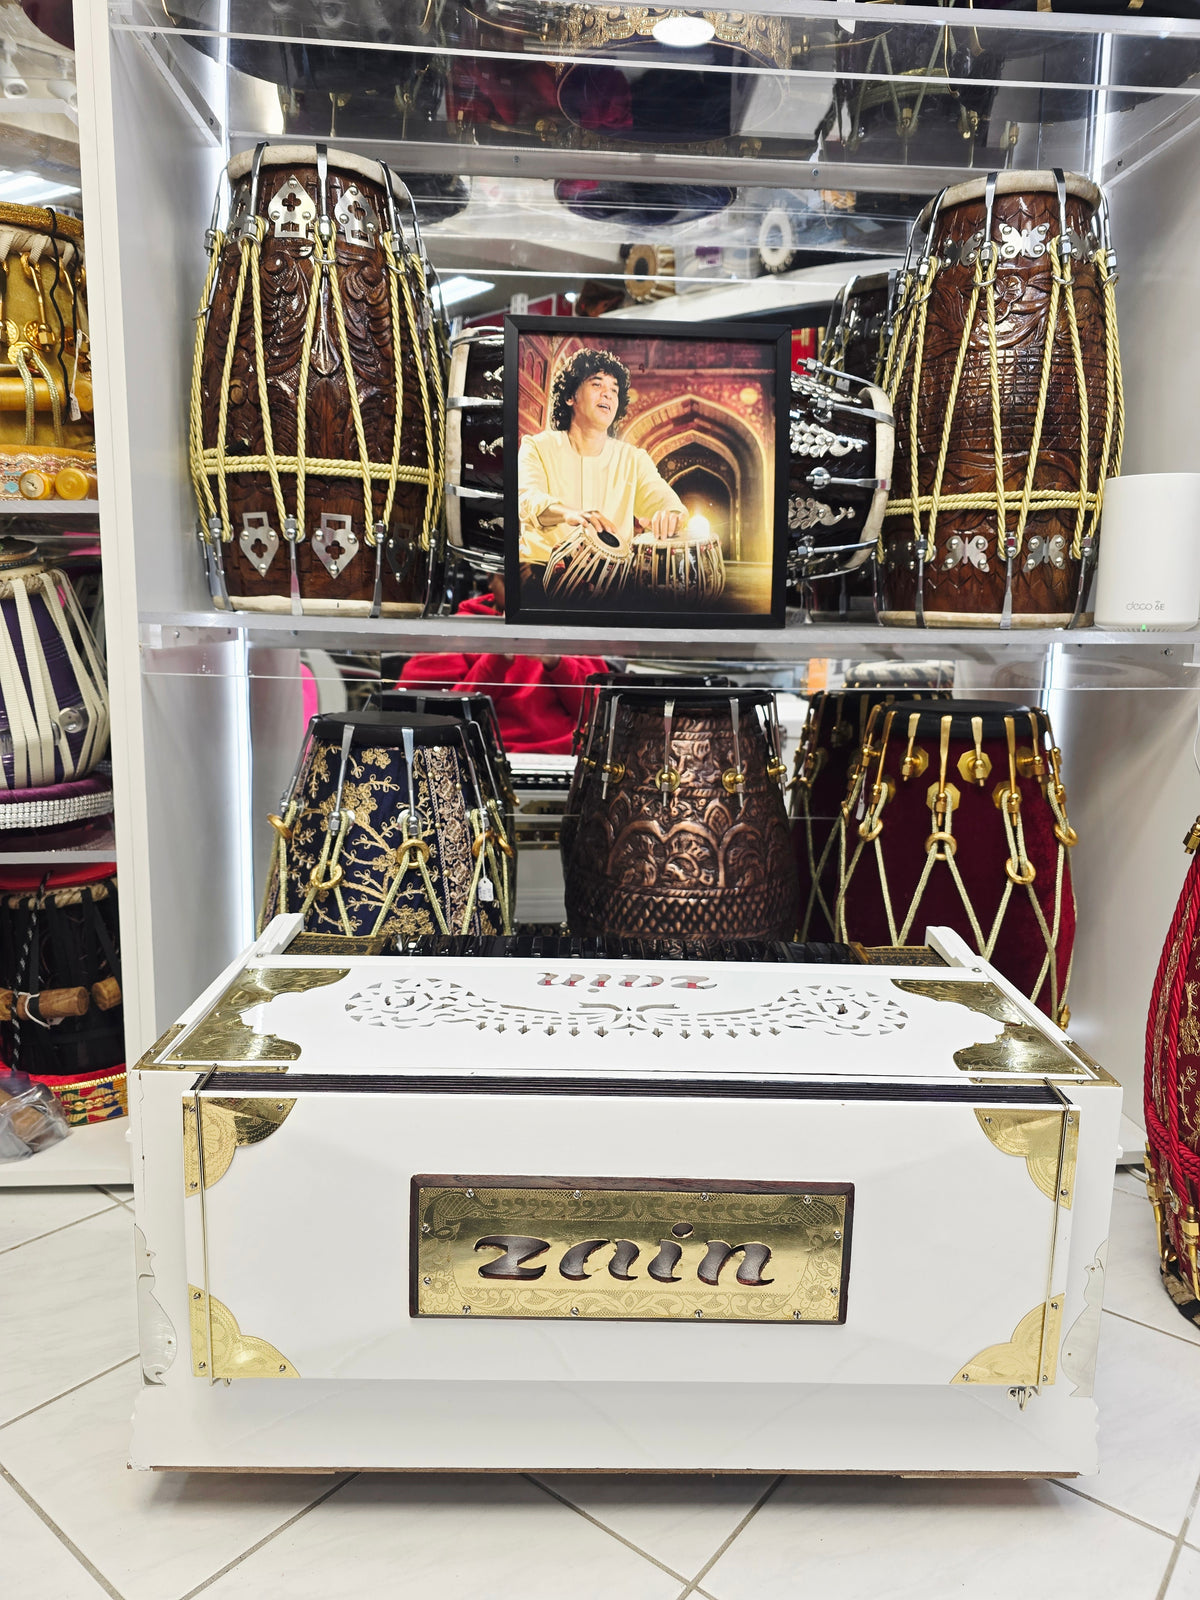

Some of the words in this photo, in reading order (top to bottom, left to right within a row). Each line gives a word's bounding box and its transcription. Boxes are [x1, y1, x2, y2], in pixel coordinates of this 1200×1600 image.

[1126, 601, 1152, 610] deco
[536, 972, 718, 994] zain
[473, 1222, 775, 1286] zain
